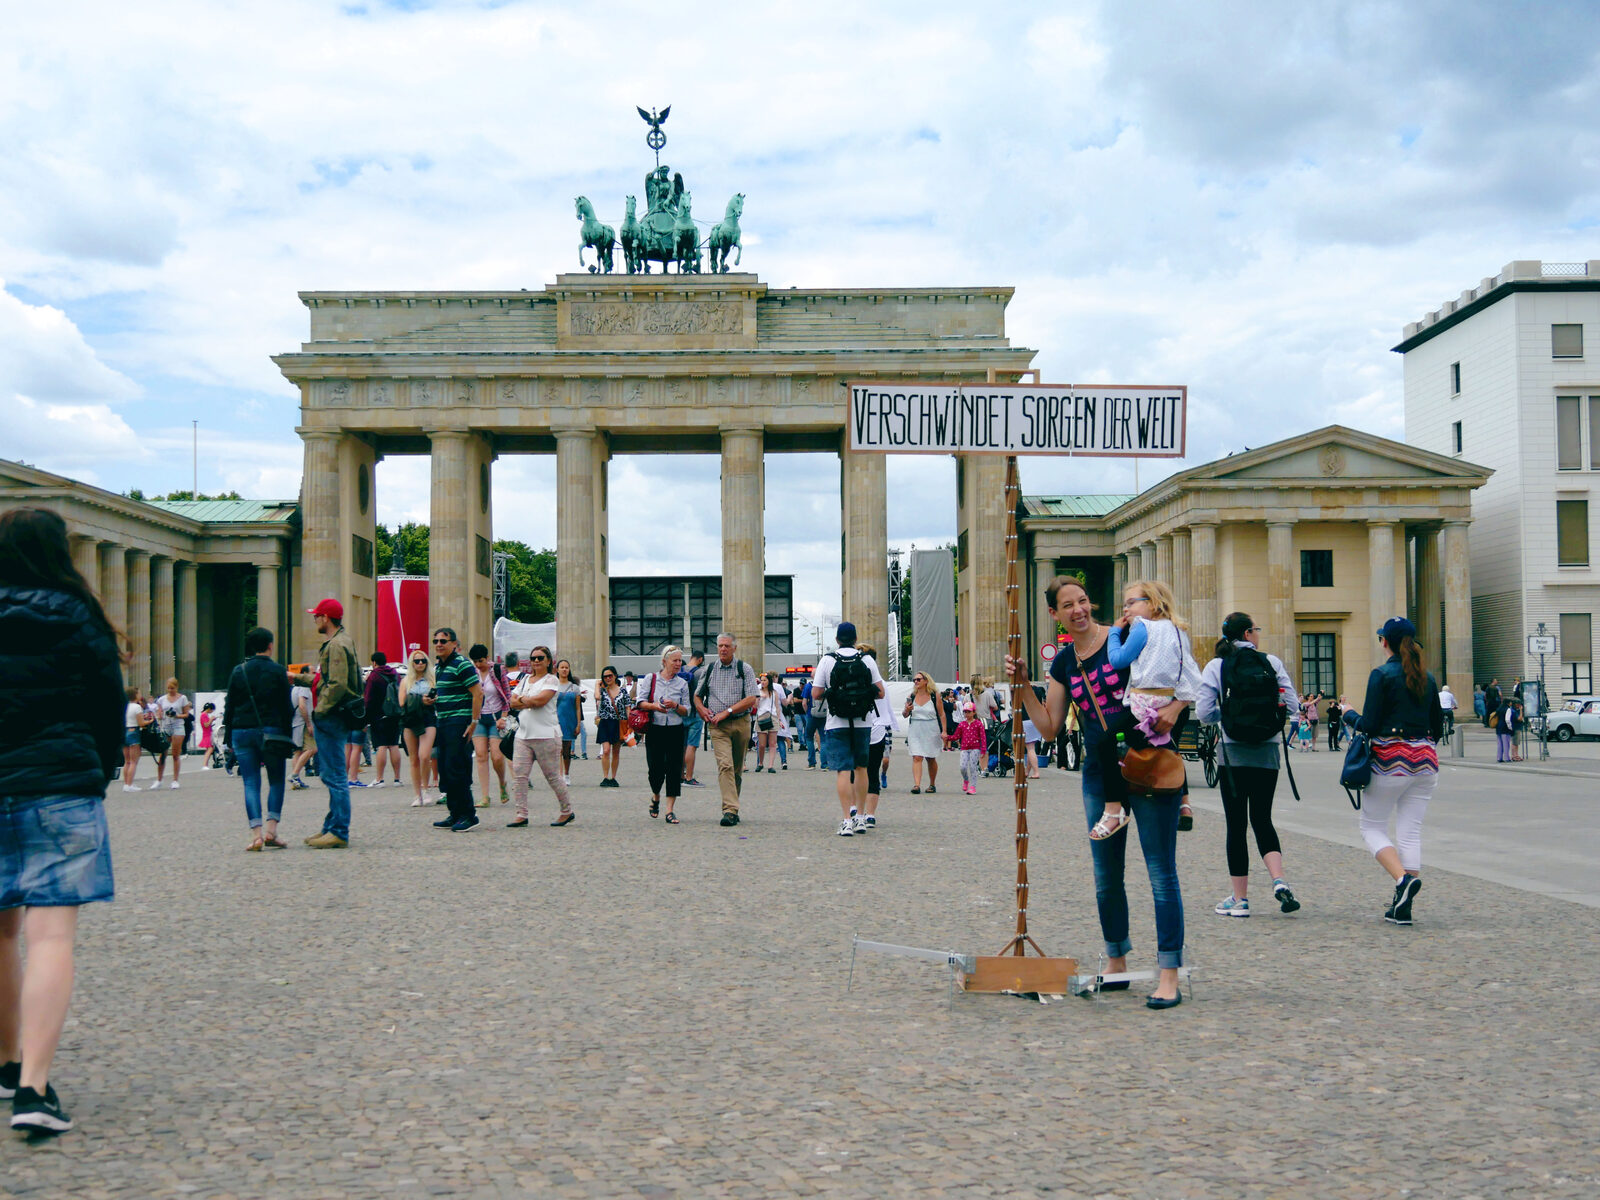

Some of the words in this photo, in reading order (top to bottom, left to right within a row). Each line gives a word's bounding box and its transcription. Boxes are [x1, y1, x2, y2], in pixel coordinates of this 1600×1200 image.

[1021, 395, 1097, 449] SORGEN
[1102, 397, 1132, 450] DER
[1135, 396, 1181, 449] WELT
